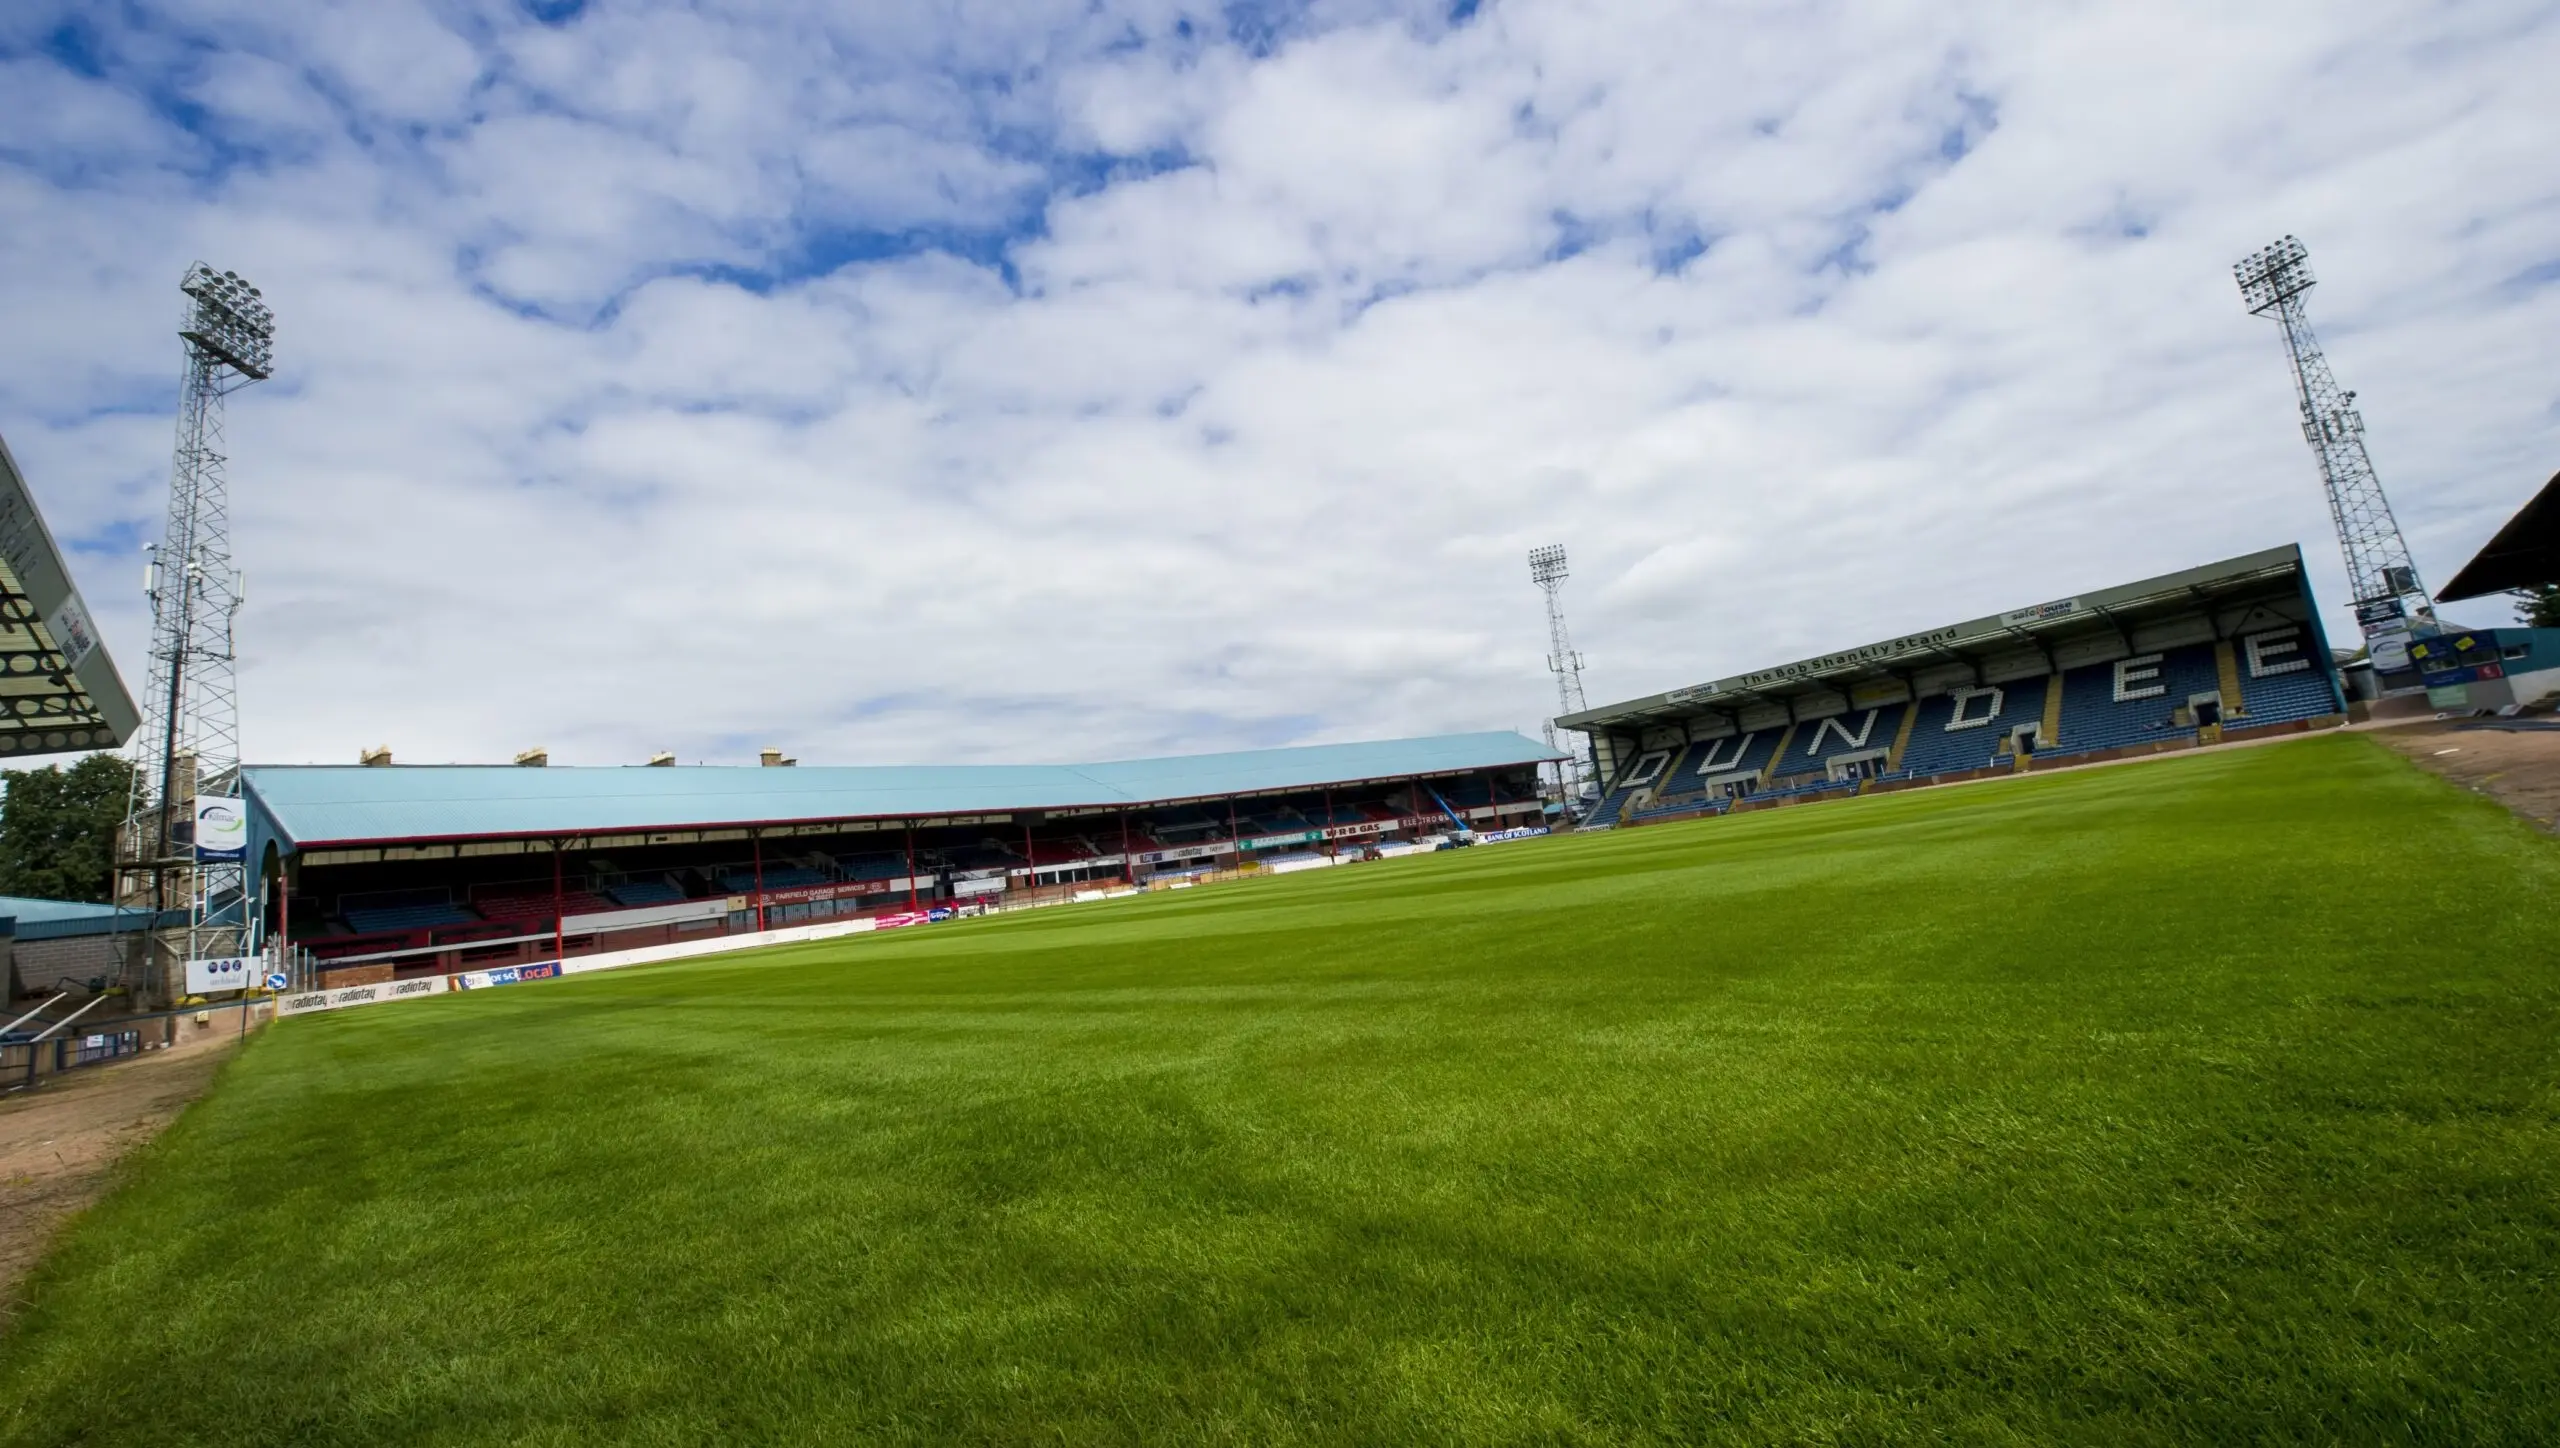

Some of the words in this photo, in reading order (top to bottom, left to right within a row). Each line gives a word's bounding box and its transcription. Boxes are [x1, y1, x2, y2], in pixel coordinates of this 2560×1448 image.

[1741, 672, 1771, 686] The
[1775, 664, 1807, 678] Bob
[1812, 645, 1889, 669] Shankly
[1895, 628, 1957, 650] Stand
[1360, 823, 1380, 834] GAS
[1487, 832, 1504, 842] BANK
[1513, 827, 1548, 838] SCOTLAND
[775, 890, 808, 900] FAIRFIELD
[809, 887, 835, 897] GARAGE
[396, 980, 432, 994] radiotay
[292, 994, 327, 1009] radiotay
[339, 988, 376, 1002] radiotay
